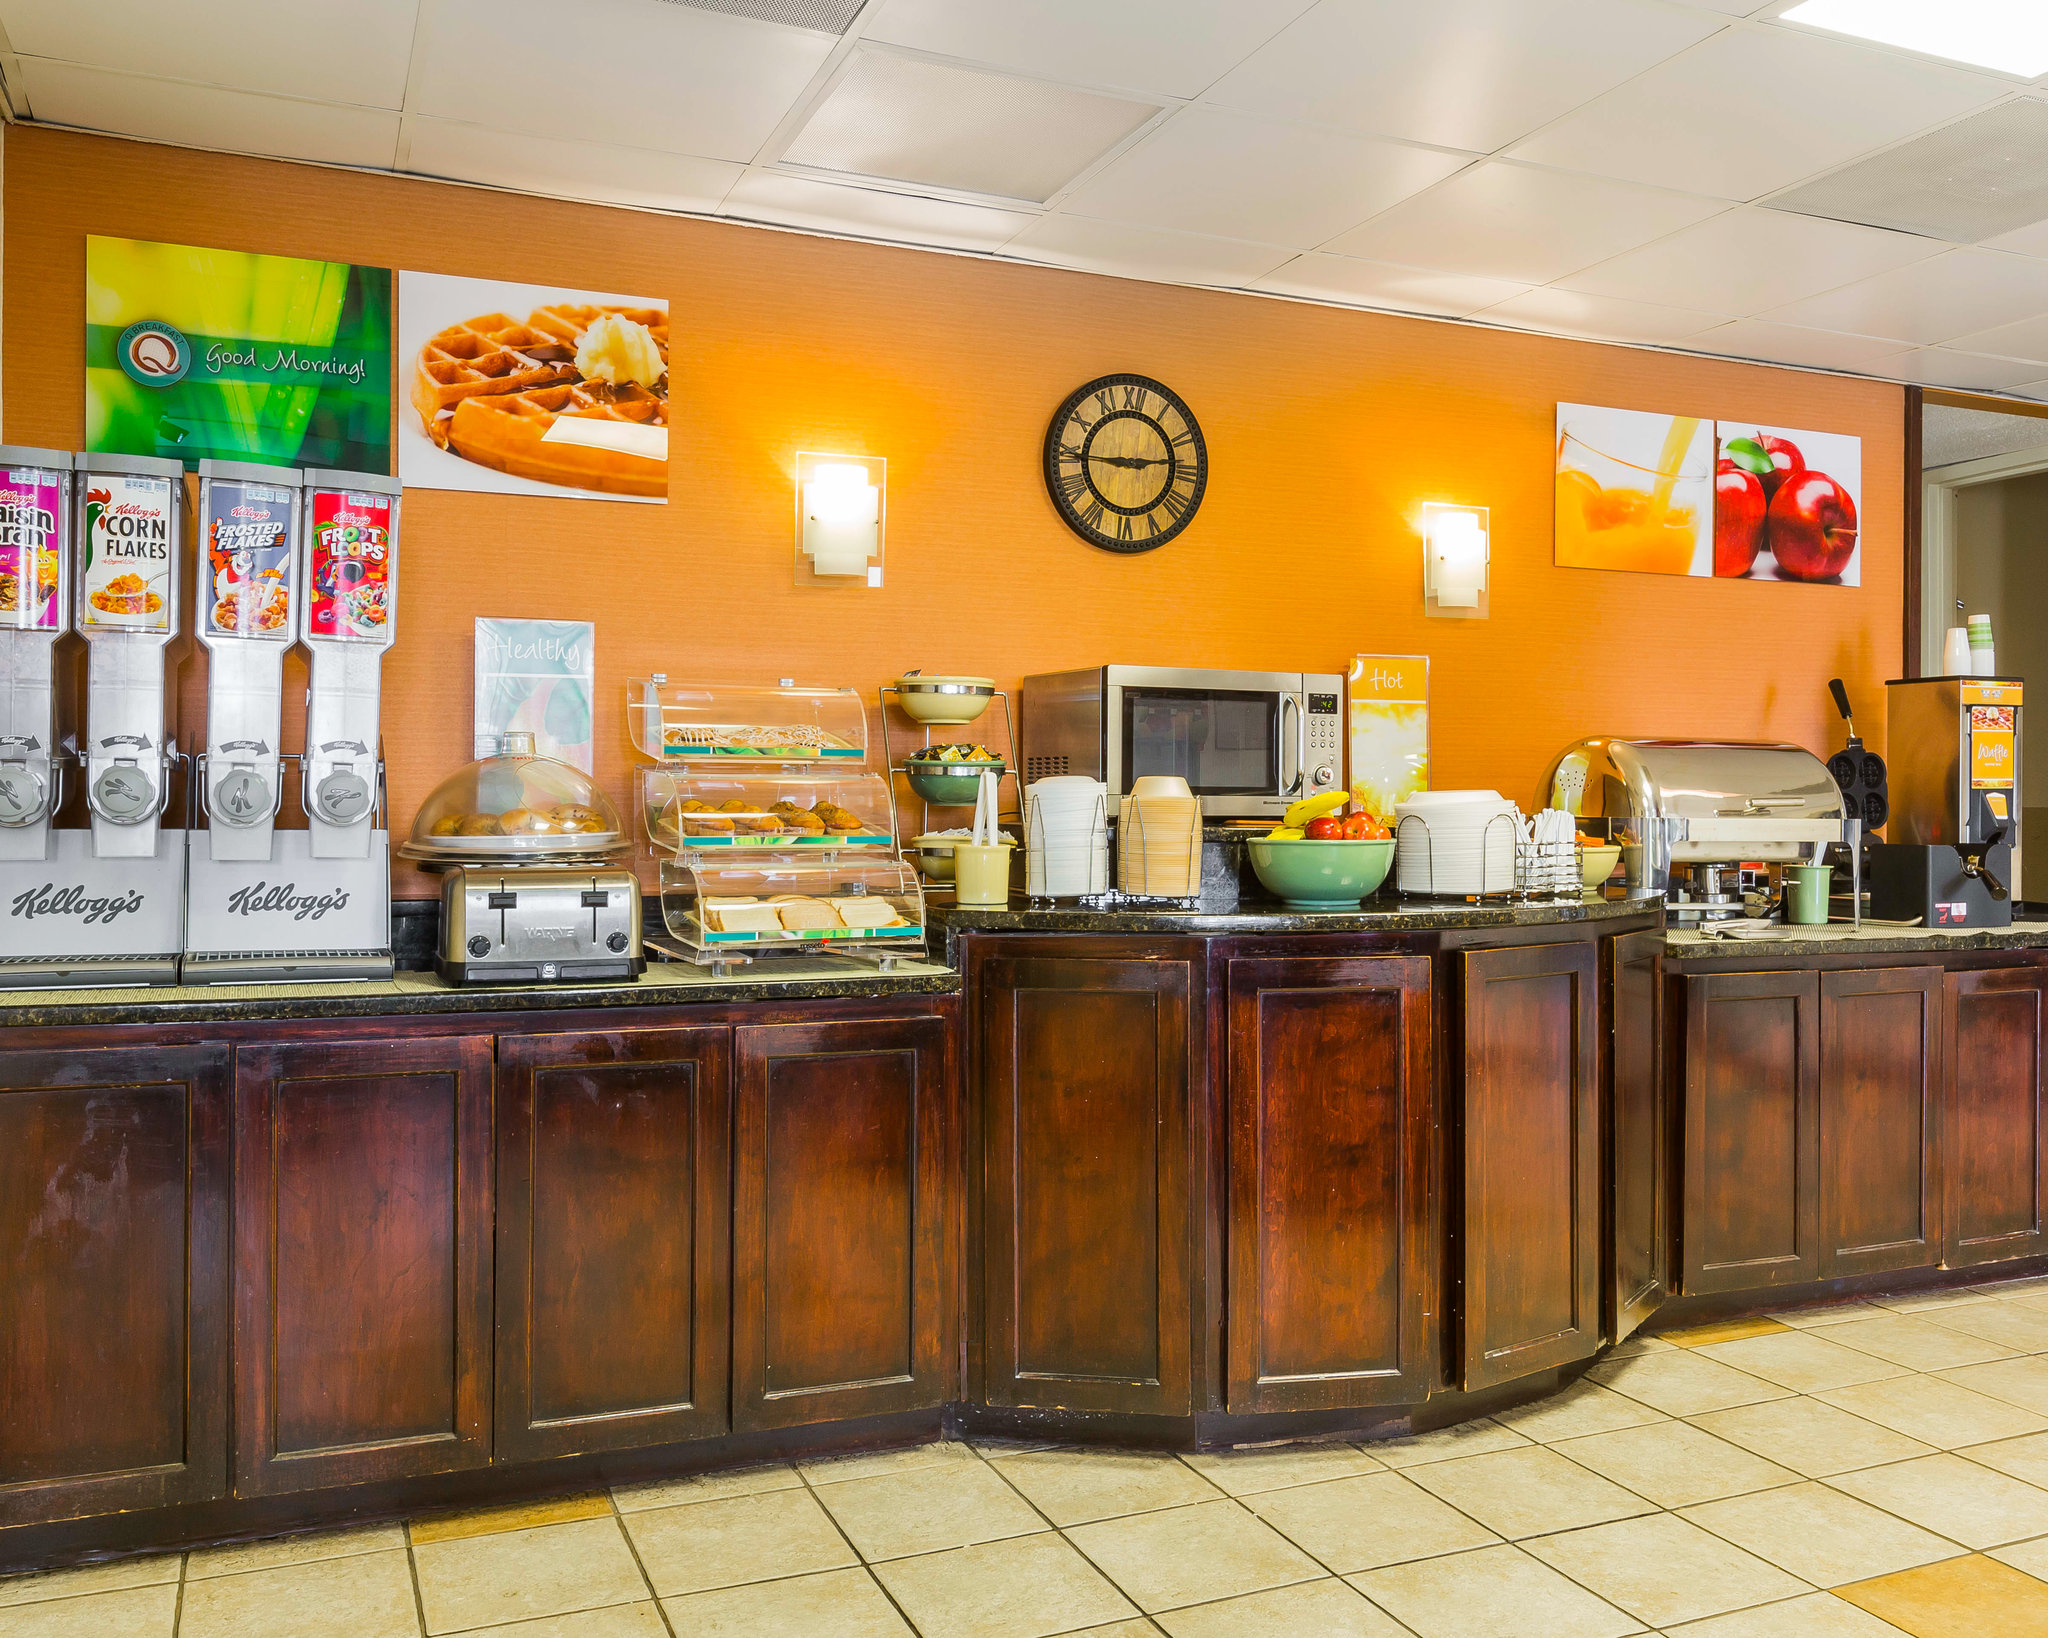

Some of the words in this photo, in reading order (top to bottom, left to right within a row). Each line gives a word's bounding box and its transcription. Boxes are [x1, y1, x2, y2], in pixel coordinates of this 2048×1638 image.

[125, 333, 134, 341] Q
[131, 322, 185, 345] BREAKFAST
[132, 334, 181, 374] Q
[206, 343, 257, 374] Good
[262, 350, 366, 385] Morning!
[115, 502, 161, 520] Kellogg's
[231, 505, 271, 521] Kellogg's
[333, 511, 372, 526] Kellogg's
[105, 515, 166, 540] CORN
[215, 521, 284, 539] FROSTED
[321, 525, 382, 546] FROOT
[106, 539, 167, 560] FLAKES
[216, 534, 275, 551] FLAKES
[330, 541, 385, 561] LOOPS
[487, 633, 581, 671] Healthy
[1369, 667, 1404, 691] Hot
[1977, 742, 2009, 762] Waffle
[11, 882, 145, 925] Kellogg's
[227, 880, 351, 921] Kellogg's
